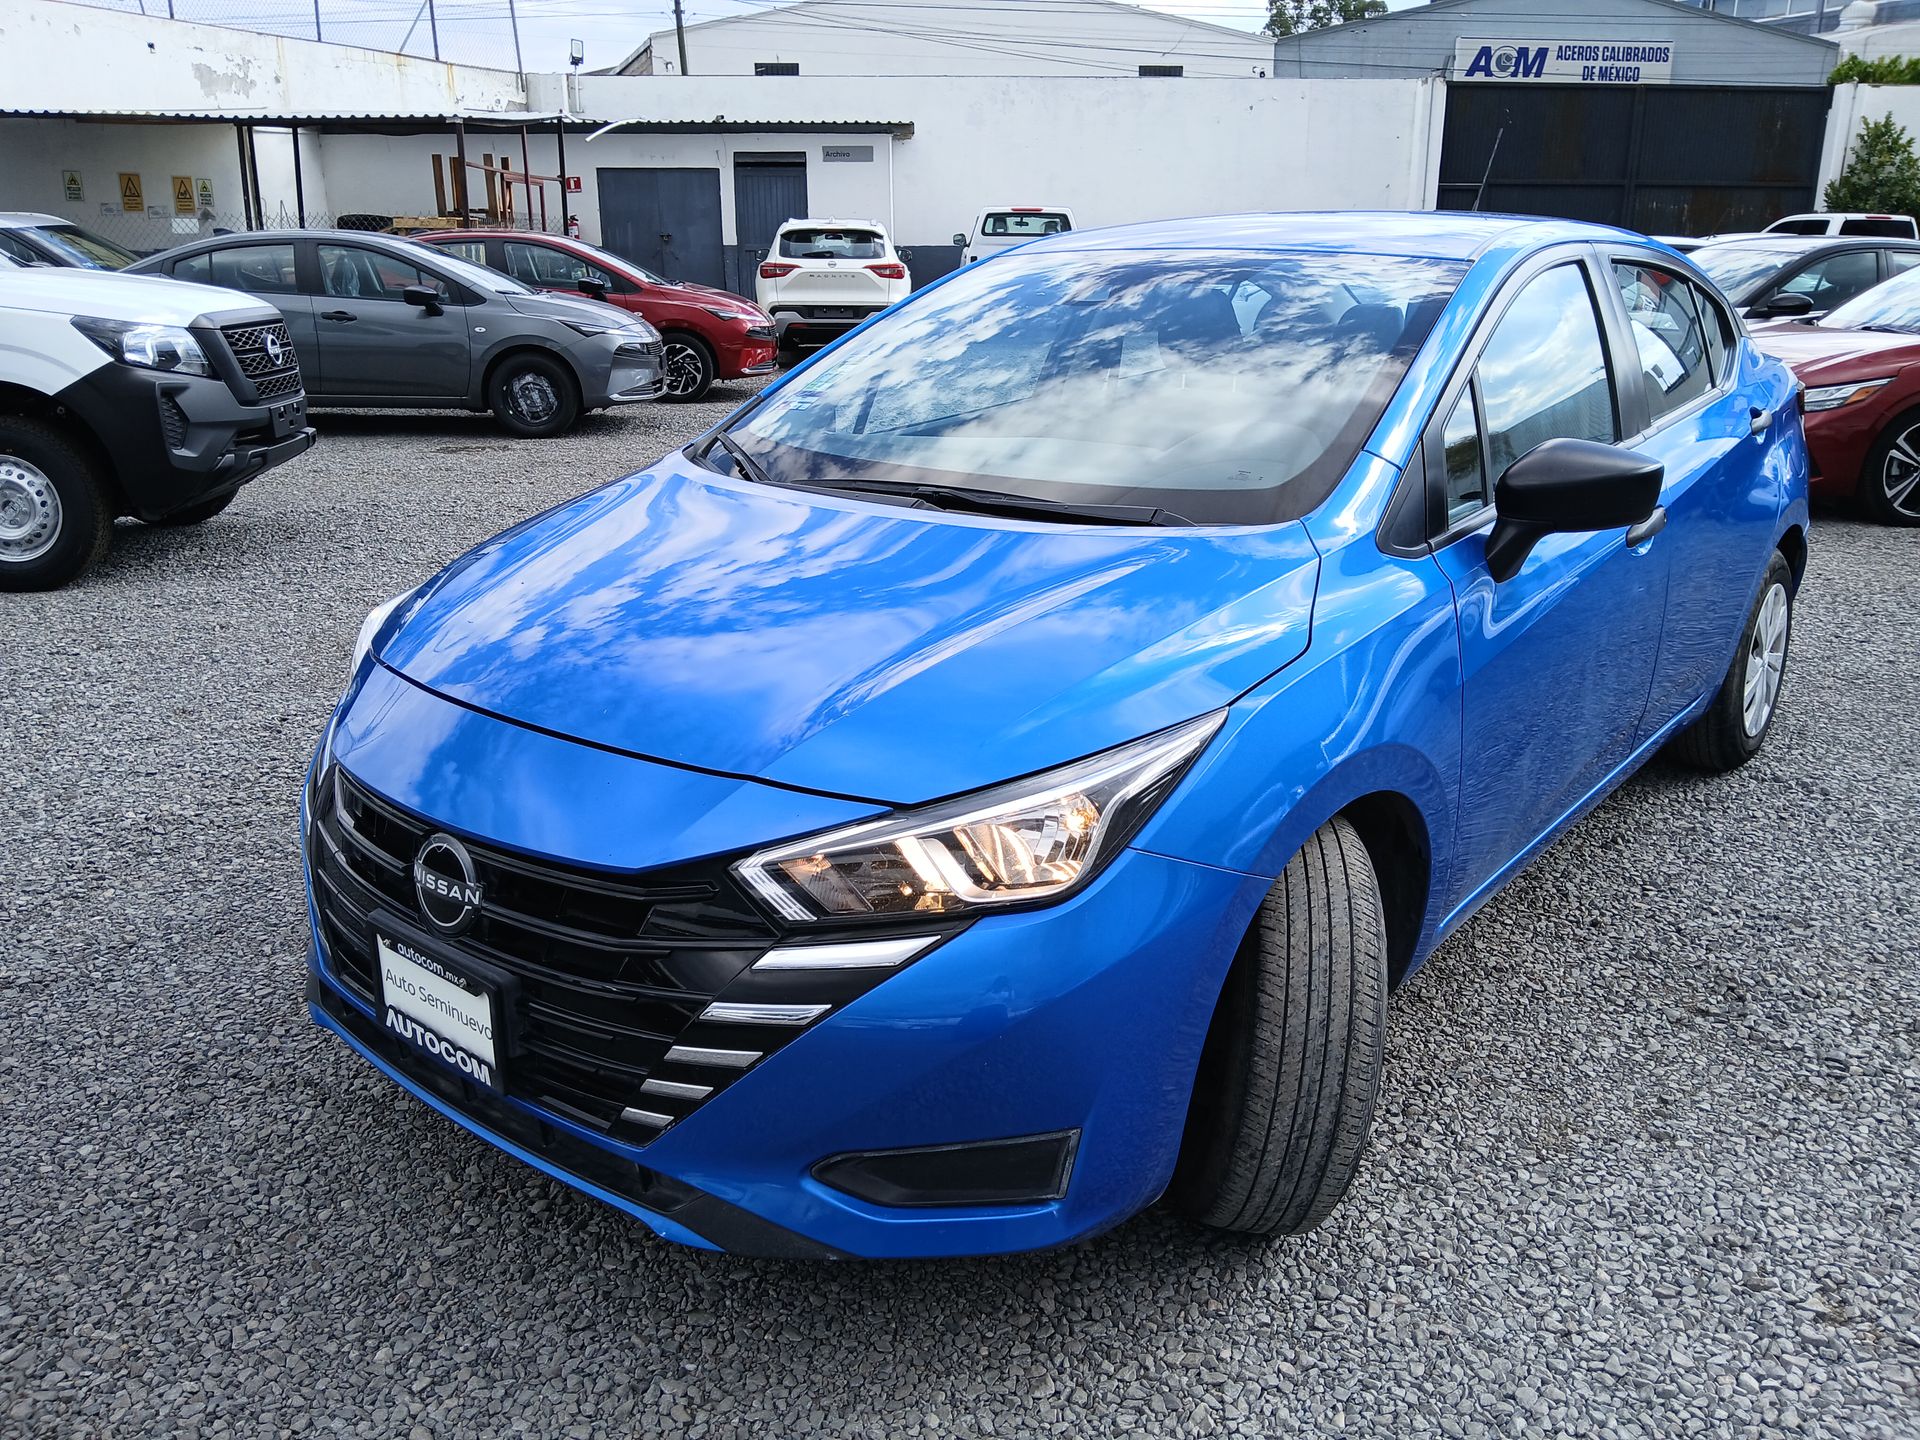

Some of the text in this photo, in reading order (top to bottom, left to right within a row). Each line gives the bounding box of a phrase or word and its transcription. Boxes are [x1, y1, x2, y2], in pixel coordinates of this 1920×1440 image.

[1556, 44, 1670, 63] ACEROS CALIBRADOS
[1582, 63, 1640, 82] DE MÉXICO
[413, 864, 480, 905] NISSAN
[385, 968, 494, 1041] Auto Seminuevo
[385, 1008, 492, 1087] AUTOCOM
